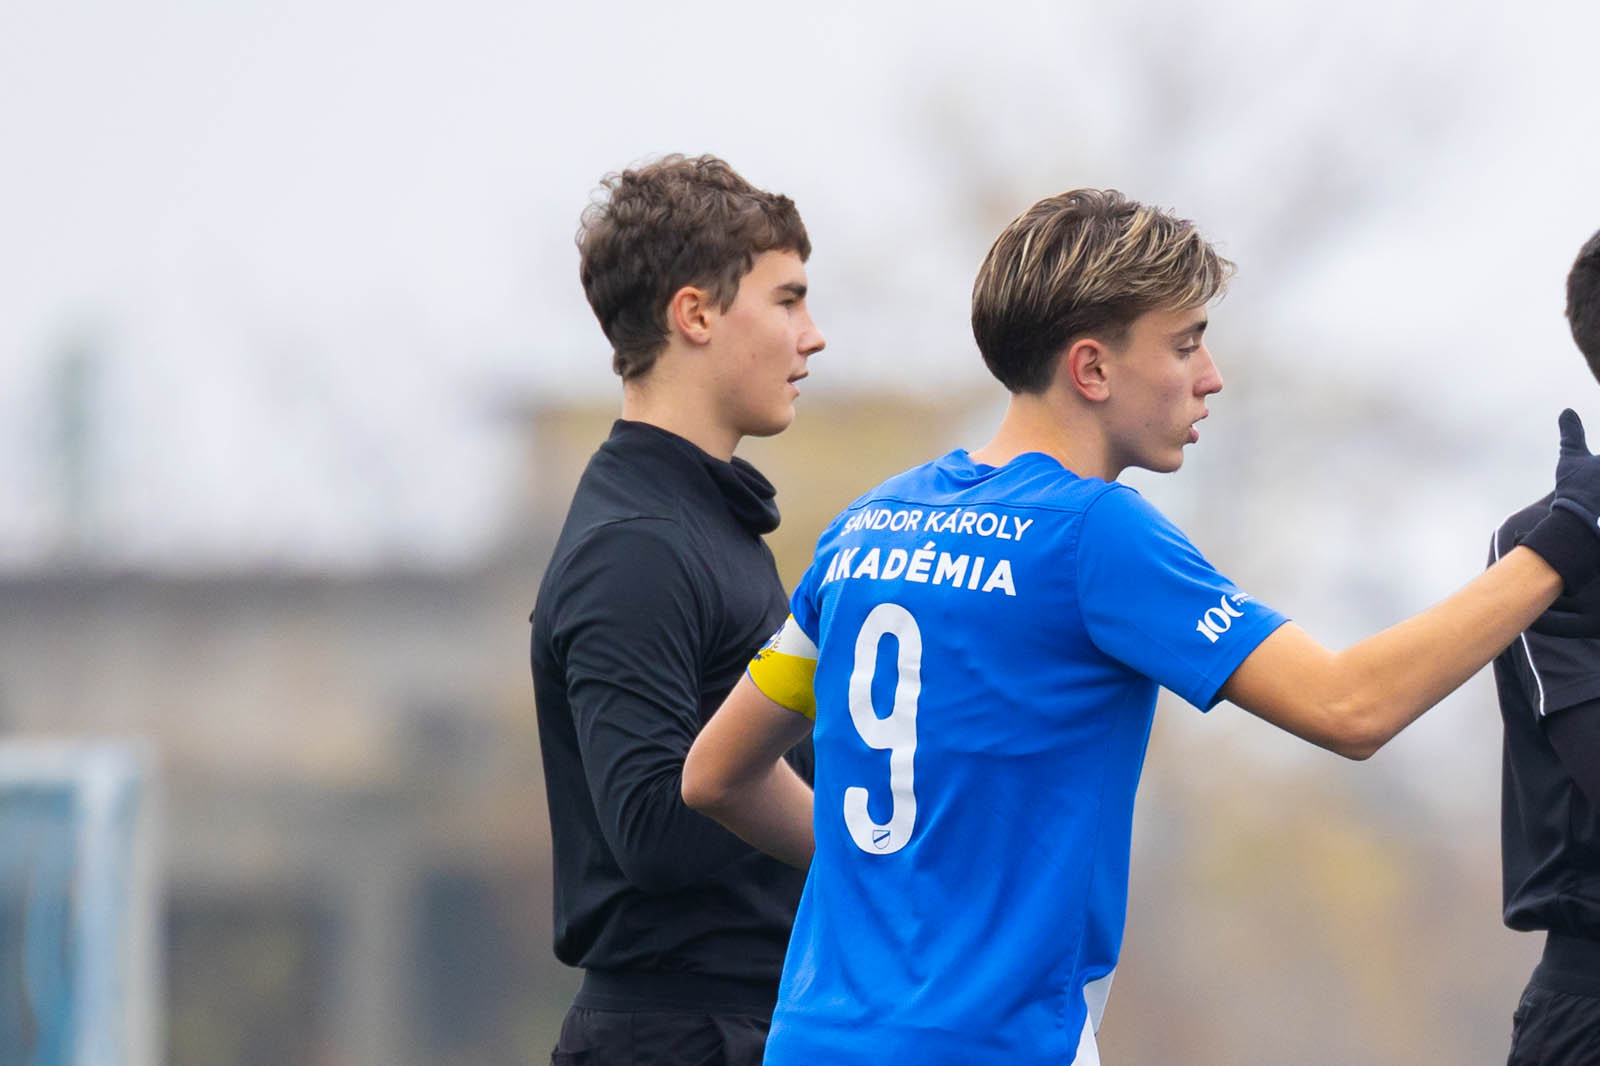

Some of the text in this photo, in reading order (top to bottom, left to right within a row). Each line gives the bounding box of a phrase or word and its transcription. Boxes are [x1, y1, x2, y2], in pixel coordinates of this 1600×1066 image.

[840, 508, 1034, 541] SÁNDOR KÁROLY
[820, 541, 1017, 596] AKADÉMIA
[843, 603, 923, 855] 9
